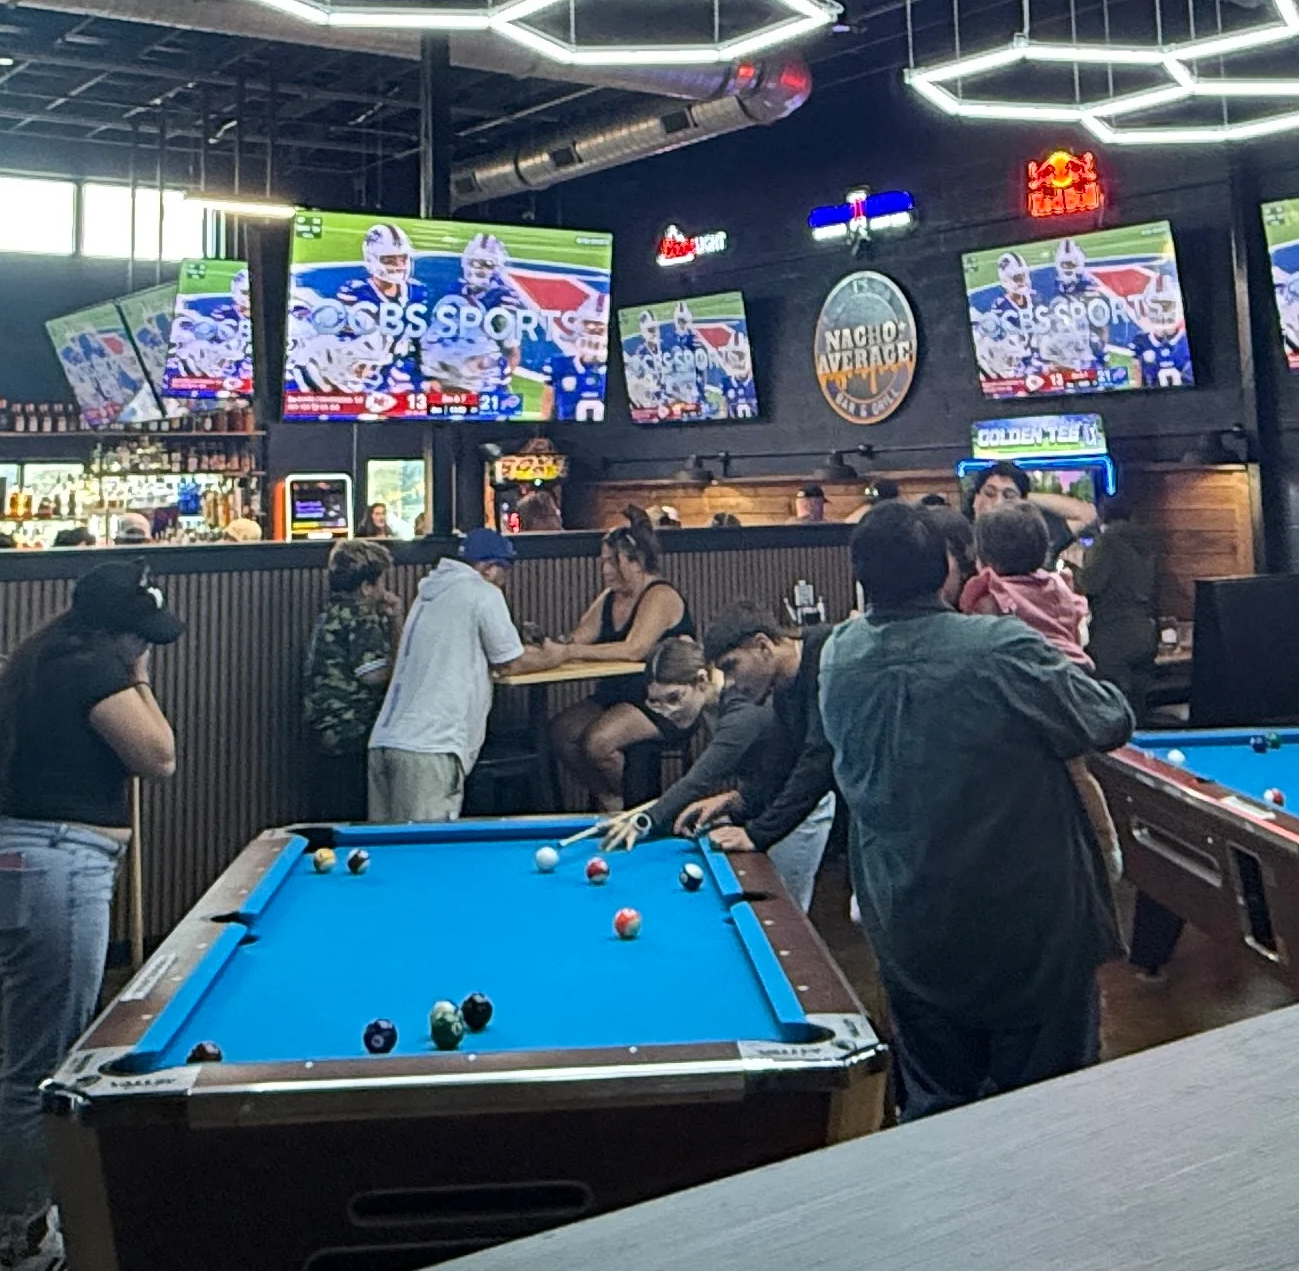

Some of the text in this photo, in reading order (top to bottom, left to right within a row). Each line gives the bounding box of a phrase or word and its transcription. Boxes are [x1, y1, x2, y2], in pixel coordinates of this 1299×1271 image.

[347, 302, 581, 341] CBS SPORTS
[1001, 297, 1163, 334] CBS SPORTS
[825, 320, 898, 353] NACHO
[817, 341, 912, 374] AVERAGE
[407, 393, 428, 410] 13
[479, 394, 499, 411] 21
[977, 424, 1080, 447] GOLDEN TEE
